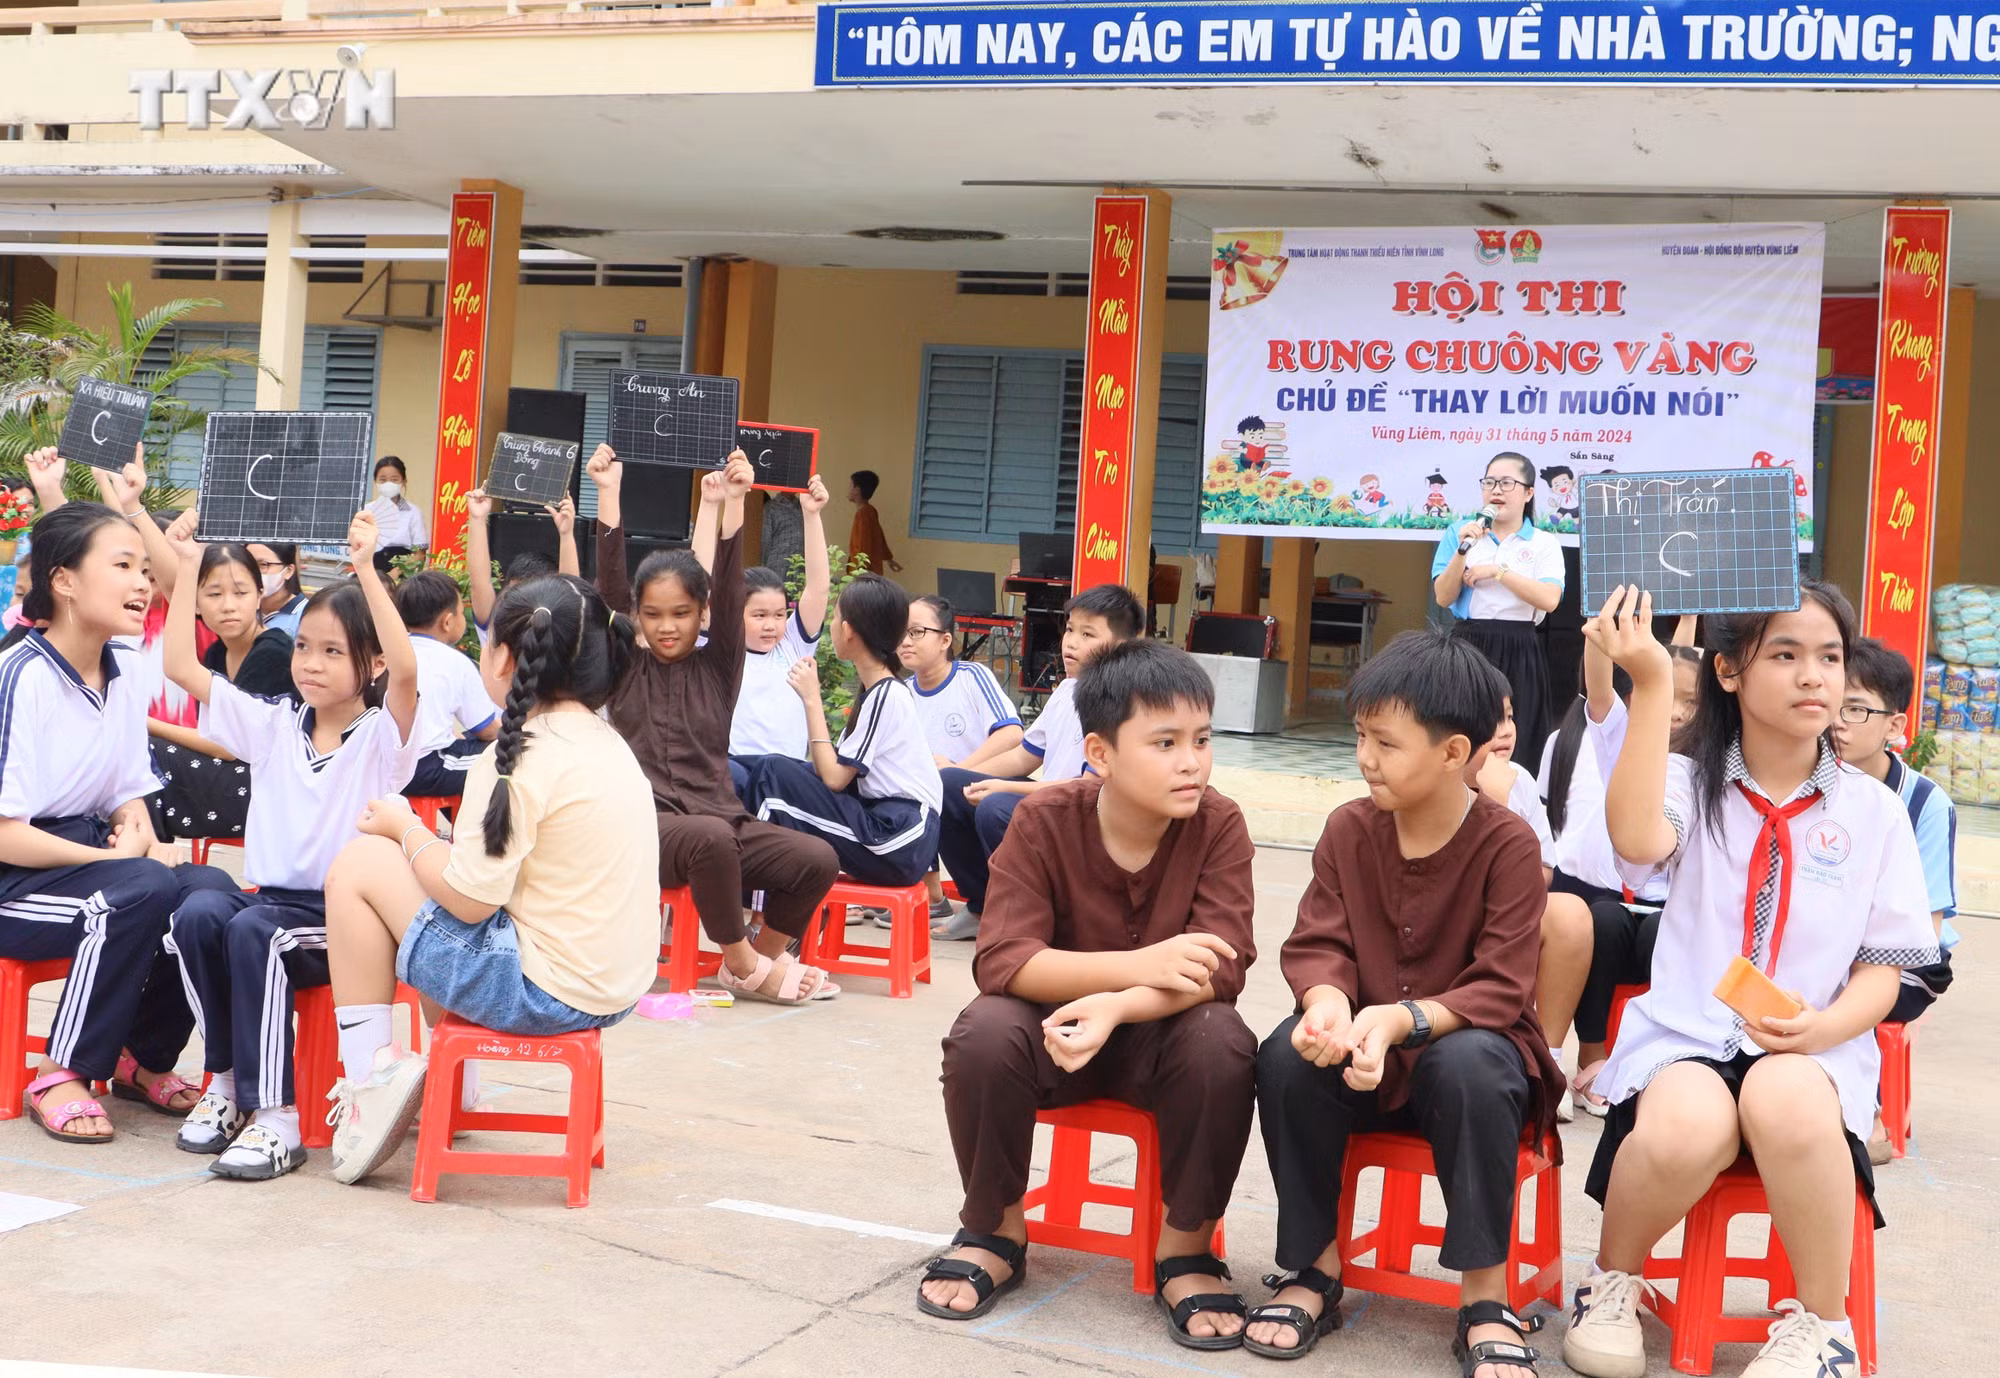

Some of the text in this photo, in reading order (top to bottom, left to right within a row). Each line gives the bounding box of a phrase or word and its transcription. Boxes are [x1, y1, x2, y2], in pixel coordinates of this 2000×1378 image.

[848, 17, 961, 66] “HÔM
[976, 22, 1077, 69] NAY,
[1092, 12, 1183, 63] CÁC
[1199, 18, 1272, 62] EM
[1289, 11, 1351, 71] TỰ
[1362, 7, 1461, 62] HÀO
[1477, 2, 1542, 61] VỀ
[1558, 4, 1665, 61] NHÀ
[1682, 5, 1913, 67] TRƯỜNG;
[457, 216, 486, 250] Tiên
[453, 280, 481, 323] Học
[1392, 271, 1626, 322] HỘI THI
[452, 349, 476, 383] Lễ
[1267, 330, 1757, 375] RUNG CHUÔNG VÀNG
[1085, 221, 1134, 562] Thầy Mẫu Mực Trò Chăm
[1276, 379, 1739, 417] CHỦ ĐỀ “THAY LỜI MUỐN NÓI”
[91, 410, 112, 446] C
[443, 413, 473, 456] Hậu
[654, 414, 673, 437] C
[1372, 426, 1632, 445] Vũng Liêm, ngày 31 tháng 5 năm 2024
[1880, 234, 1941, 614] Trường Khang Trang Lớp Thân
[566, 444, 579, 459] 6
[758, 449, 773, 468] C
[247, 454, 278, 500] C
[514, 473, 527, 491] C
[1586, 478, 1642, 526] Thị
[1659, 531, 1698, 577] C
[516, 1043, 531, 1055] 12
